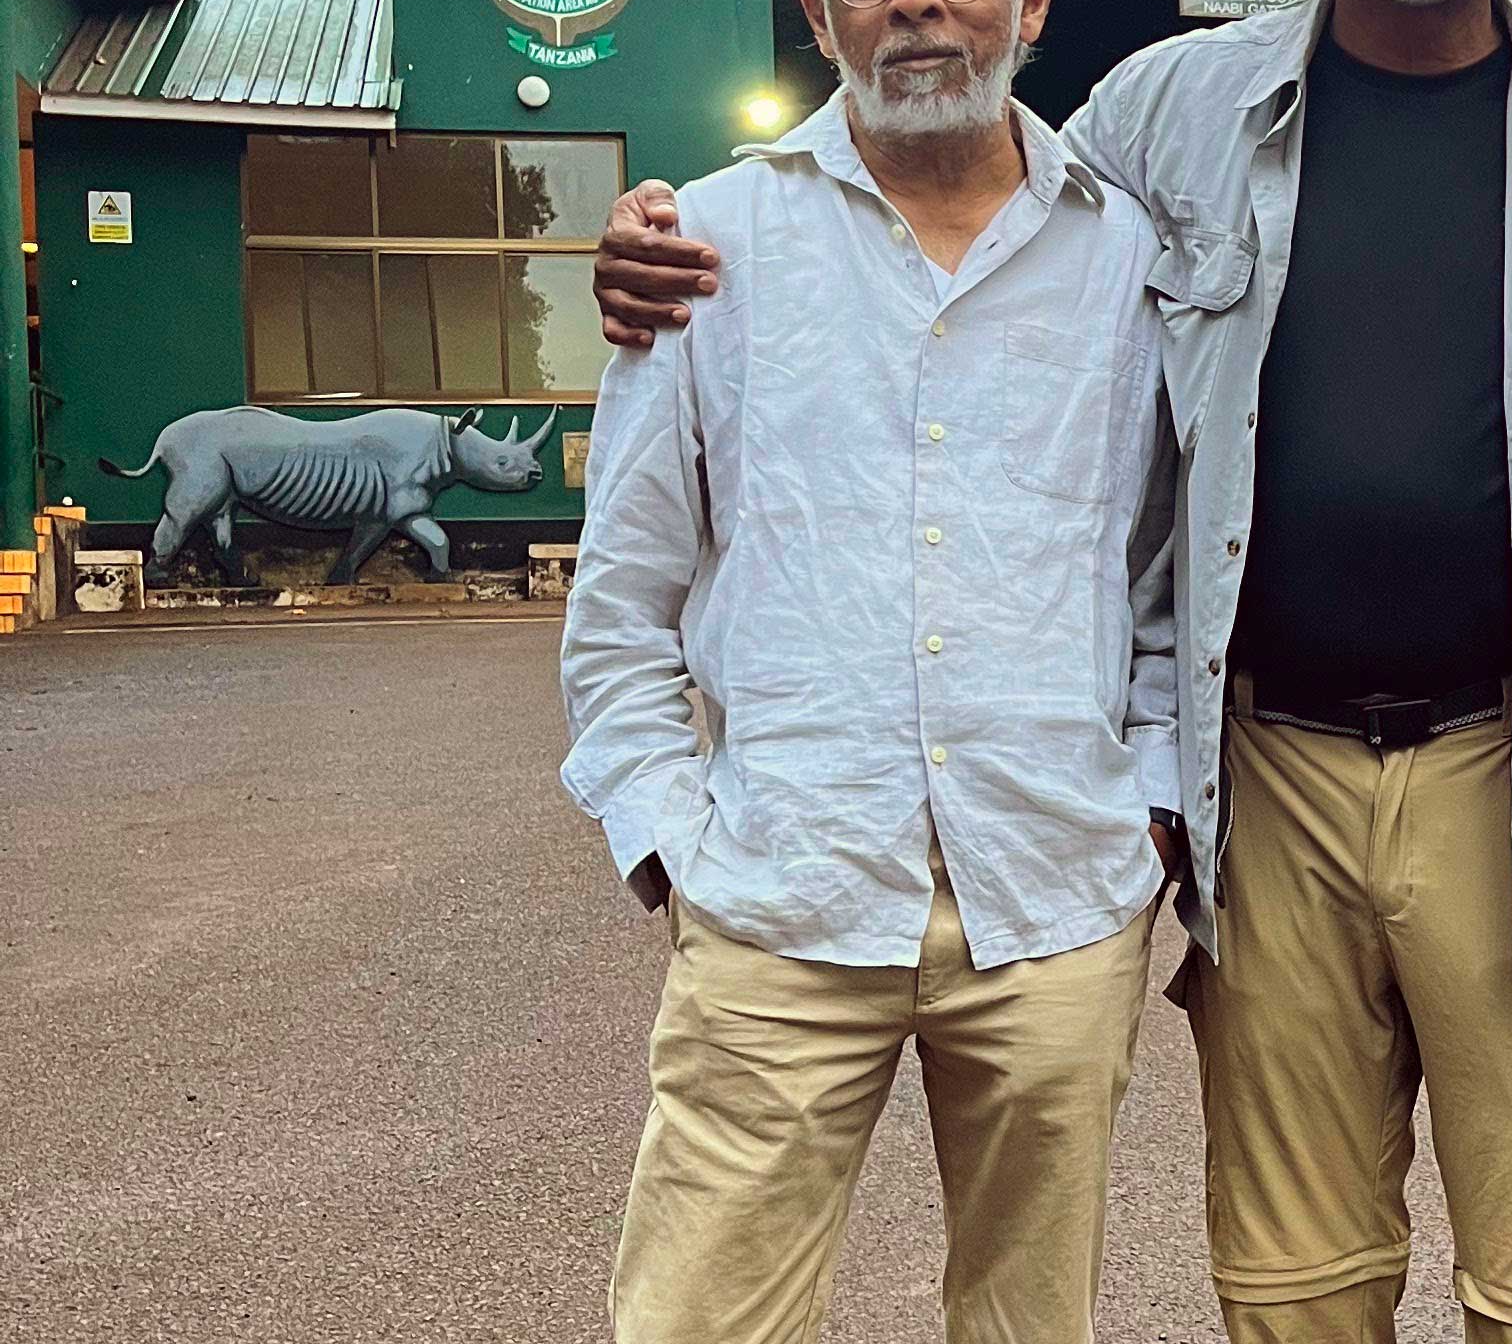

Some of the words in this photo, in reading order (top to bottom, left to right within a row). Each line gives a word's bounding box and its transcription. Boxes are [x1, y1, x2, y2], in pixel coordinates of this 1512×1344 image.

[1203, 1, 1244, 14] NAABI
[1247, 3, 1281, 14] GA
[528, 42, 597, 65] TANZANIA
